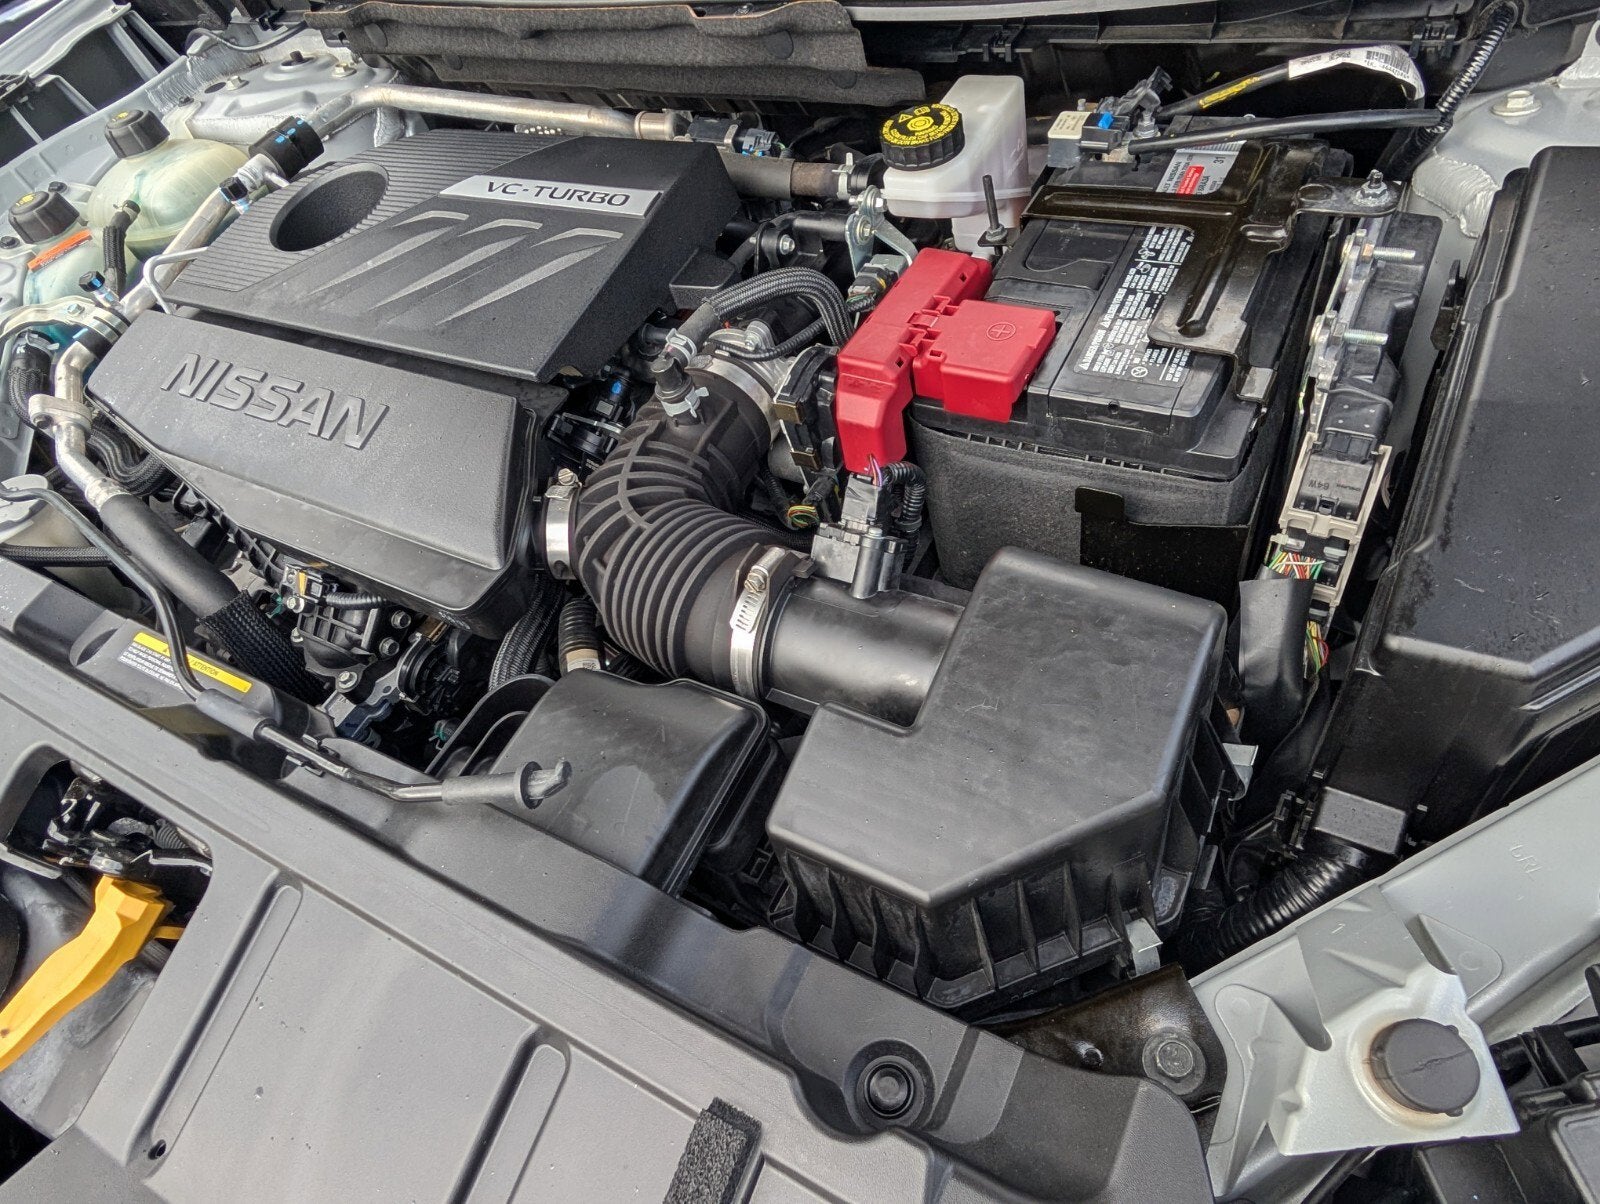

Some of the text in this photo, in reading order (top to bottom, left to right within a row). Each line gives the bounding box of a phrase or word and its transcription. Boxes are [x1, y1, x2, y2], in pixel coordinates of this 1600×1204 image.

[1213, 156, 1226, 164] 31
[1167, 161, 1182, 181] NISSAN
[487, 181, 631, 207] VC-TURBO
[160, 353, 390, 450] NISSAN
[193, 660, 219, 676] ATTENTION
